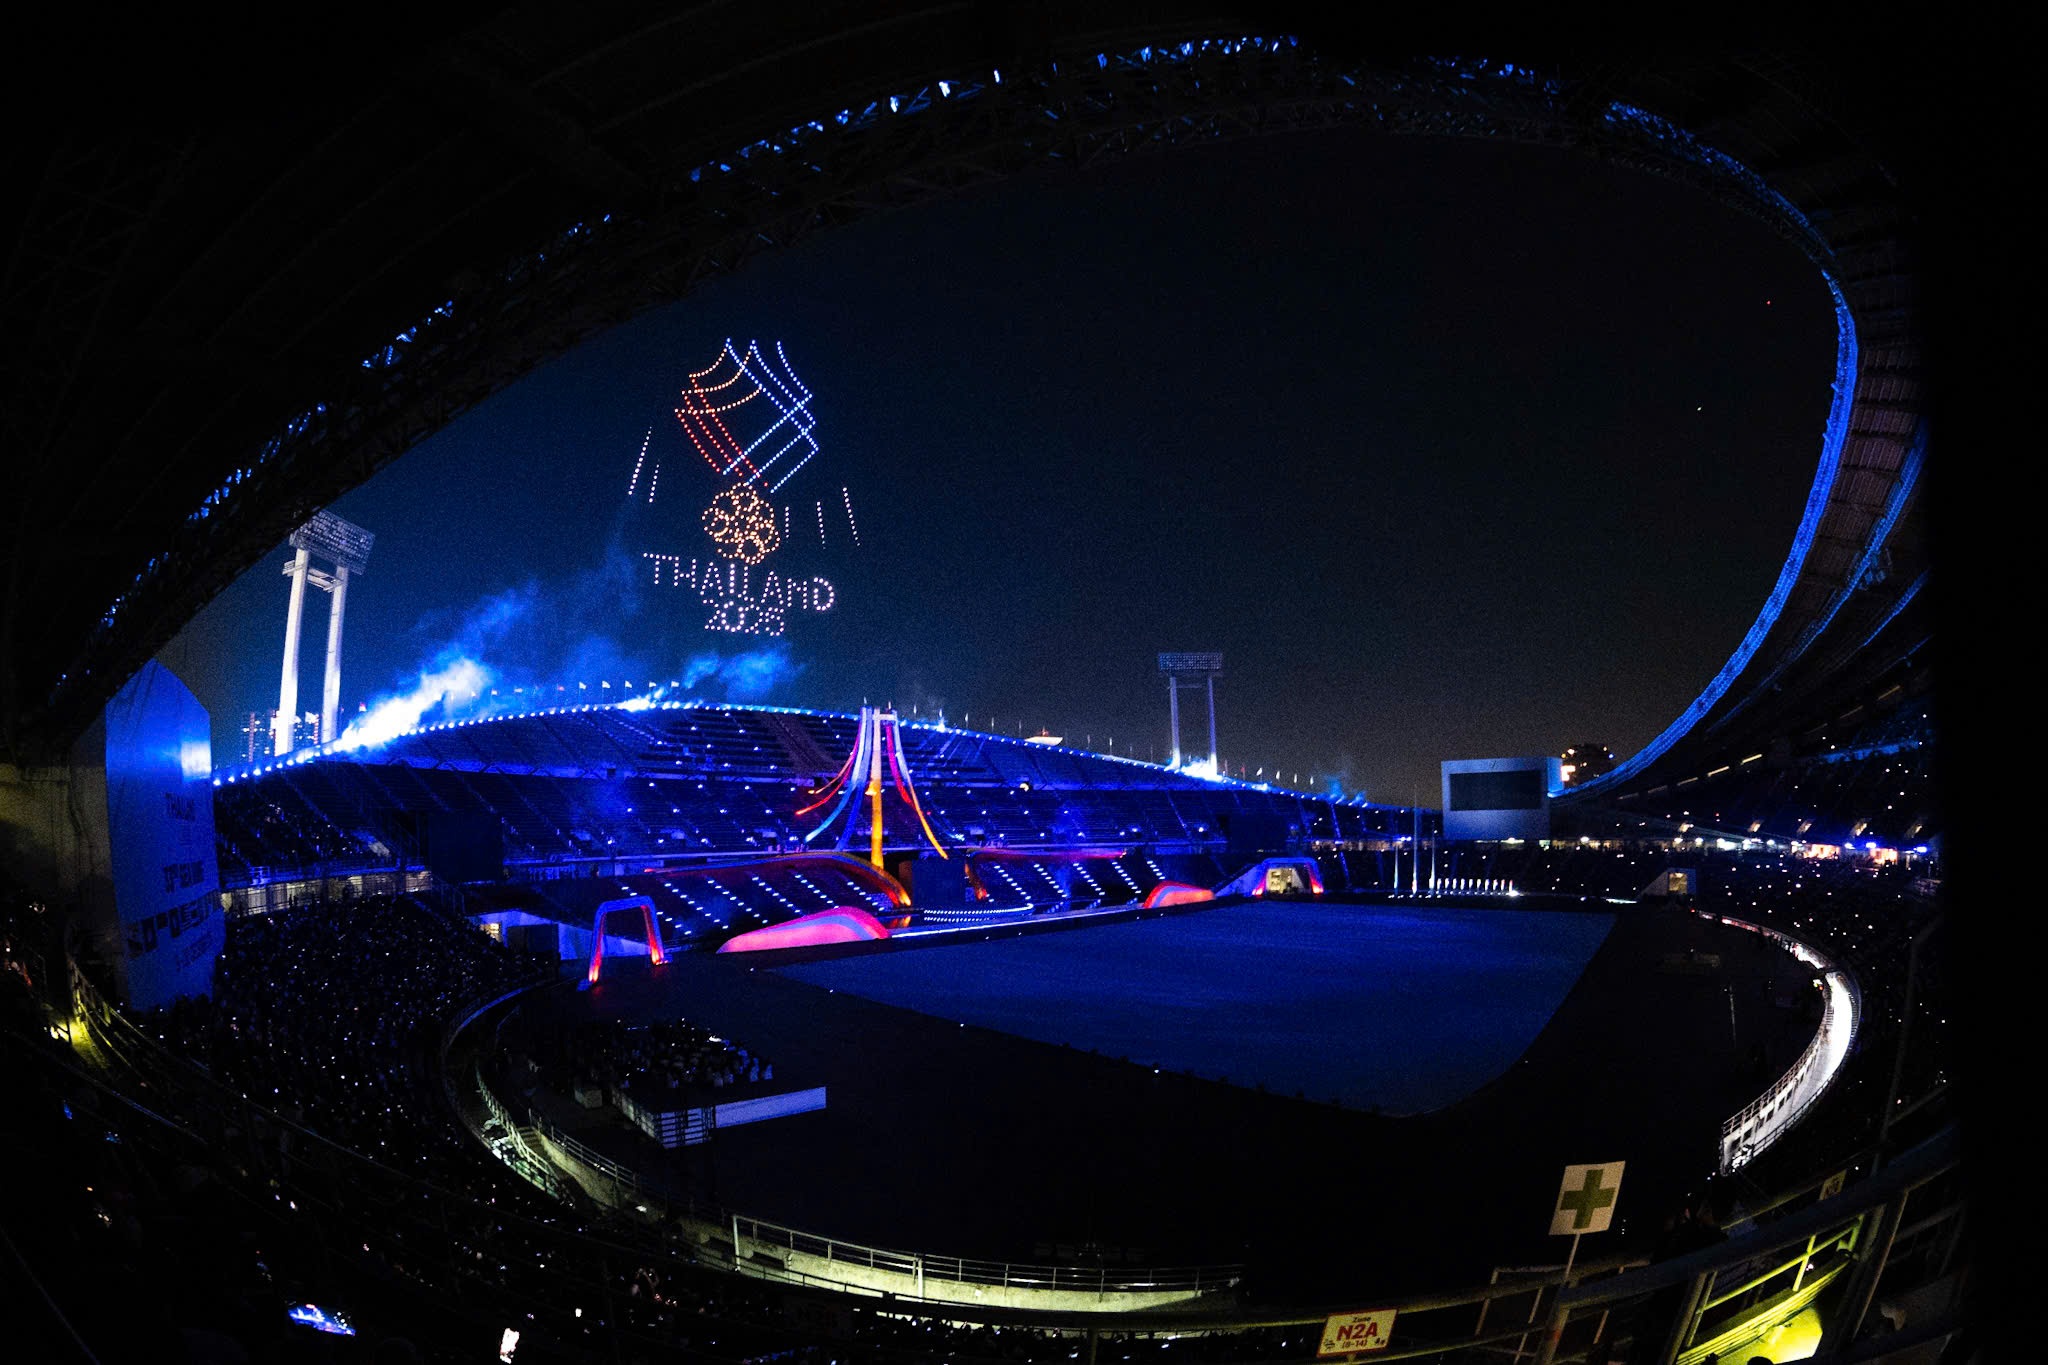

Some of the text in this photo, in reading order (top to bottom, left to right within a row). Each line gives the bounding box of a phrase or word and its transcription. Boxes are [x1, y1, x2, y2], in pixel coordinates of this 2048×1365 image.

[642, 552, 835, 611] THAILAND
[702, 599, 785, 637] 2025
[1336, 1321, 1378, 1341] N2A
